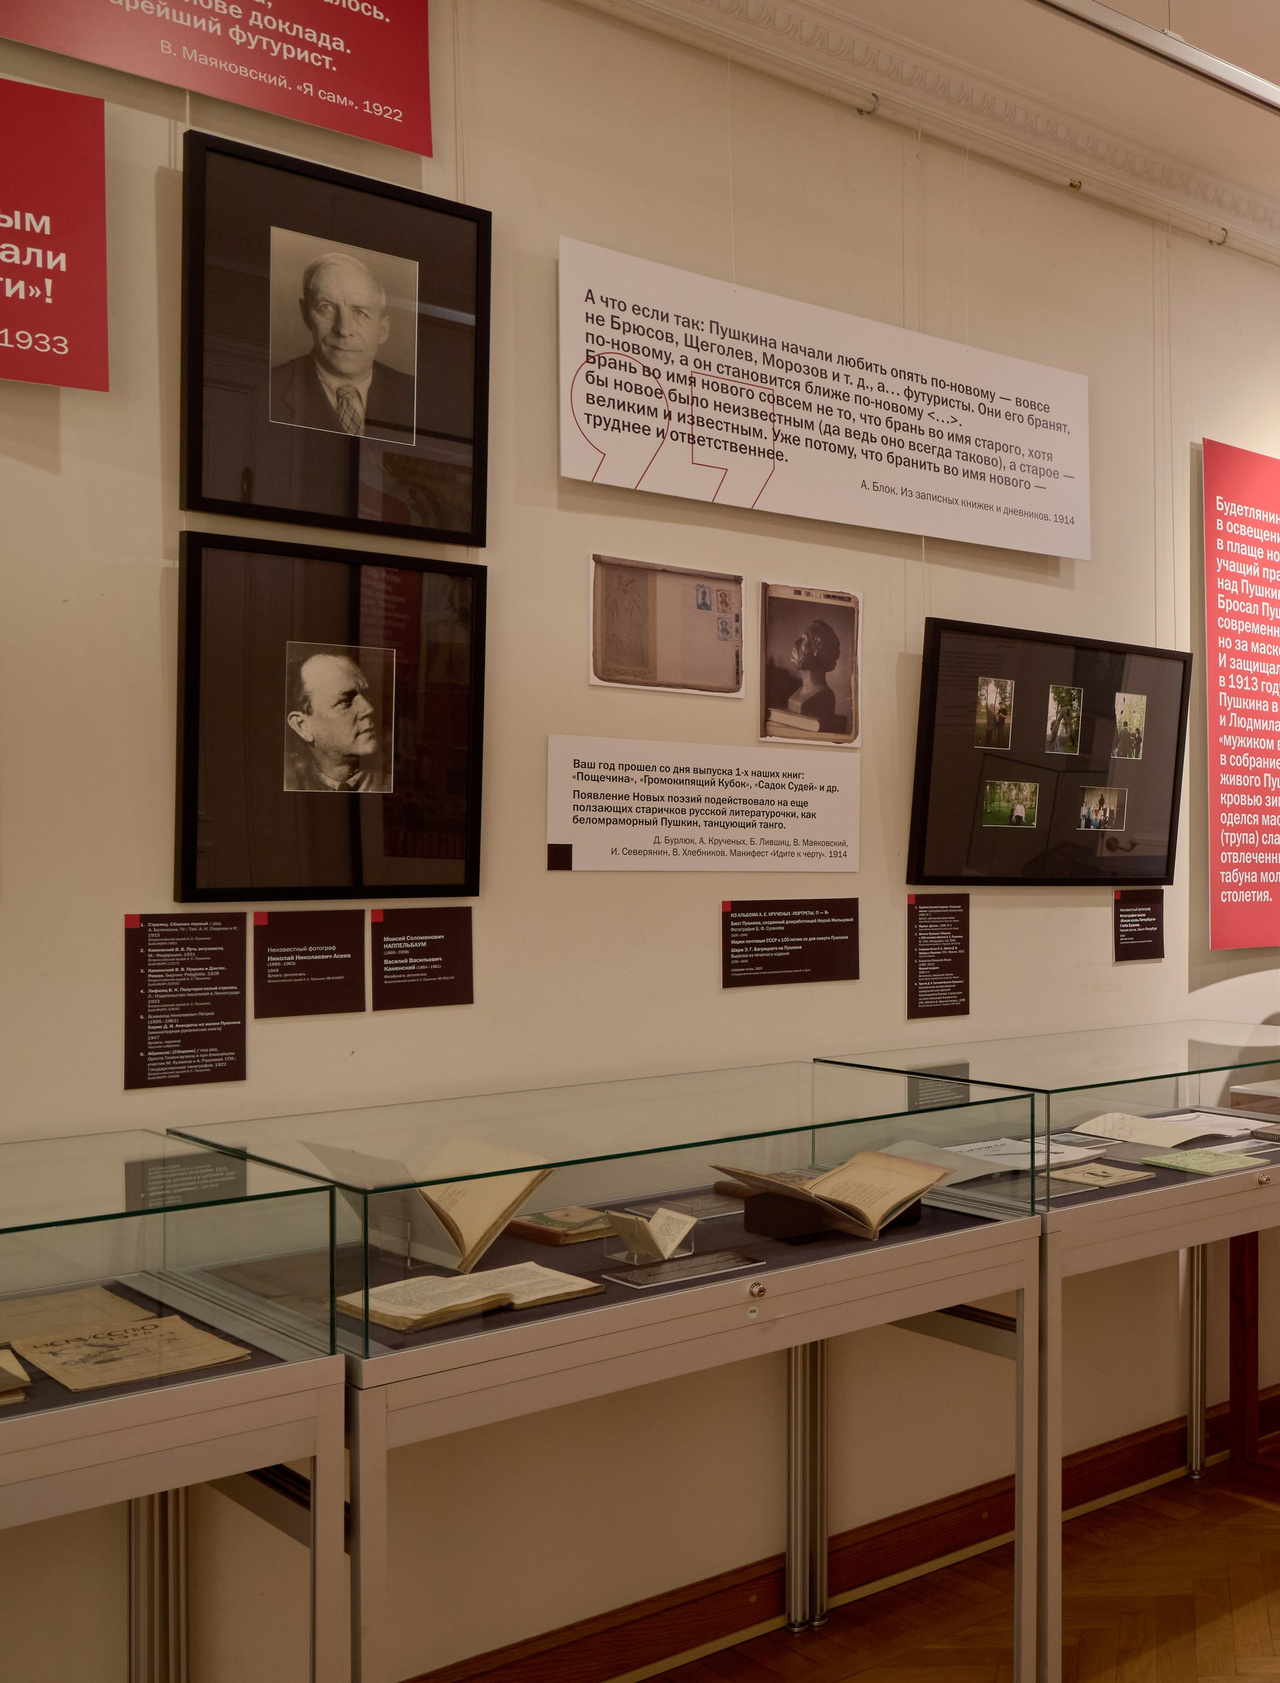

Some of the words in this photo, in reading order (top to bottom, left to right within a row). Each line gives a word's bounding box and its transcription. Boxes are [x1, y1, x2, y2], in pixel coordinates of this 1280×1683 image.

[249, 10, 352, 54] доклада.
[228, 24, 338, 72] футурист.
[160, 39, 177, 56] В.
[182, 45, 293, 90] Маяковский.
[296, 81, 314, 96] «Я
[318, 88, 359, 110] сам».
[363, 100, 403, 123] 1922
[0, 276, 53, 304] и»!
[0, 328, 69, 355] 1933
[585, 331, 674, 365] по-новому,
[679, 354, 688, 366] а
[693, 357, 711, 371] он
[716, 363, 800, 391] становится
[804, 380, 850, 402] ближе
[854, 393, 923, 421] по-новому
[585, 349, 637, 373] Брань
[641, 363, 661, 379] во
[666, 370, 696, 387] имя
[701, 378, 754, 399] нового
[759, 391, 812, 412] совсем
[816, 403, 833, 416] не
[836, 407, 855, 423] то,
[859, 412, 881, 426] что
[885, 416, 925, 435] брань
[928, 427, 944, 439] во
[947, 431, 971, 445] имя
[974, 437, 1024, 458] старого,
[1027, 448, 1052, 462] хотя
[584, 412, 651, 435] труднее
[656, 427, 665, 439] и
[670, 430, 788, 462] ответственнее.
[860, 479, 869, 490] А.
[872, 481, 898, 495] Блок.
[900, 486, 913, 498] Из
[915, 490, 959, 505] записных
[960, 499, 994, 512] книжек
[995, 505, 1001, 513] и
[1002, 506, 1051, 521] дневников.
[1053, 513, 1074, 525] 1914
[1216, 518, 1223, 530] в
[1216, 538, 1223, 550] в
[1226, 540, 1263, 560] плаще
[1216, 557, 1259, 577] учащий
[1218, 593, 1258, 614] Бросал
[1218, 636, 1232, 649] но
[1234, 639, 1248, 651] за
[1219, 675, 1225, 687] в
[1228, 673, 1258, 691] 1913
[1218, 734, 1274, 750] «мужиком
[573, 758, 595, 769] Ваш
[598, 762, 615, 772] год
[618, 763, 656, 772] прошел
[658, 765, 670, 773] со
[672, 765, 690, 774] дня
[692, 766, 733, 777] выпуска
[735, 767, 749, 776] 1-х
[750, 770, 780, 778] наших
[781, 771, 804, 779] книг:
[572, 771, 637, 784] «Пощечина»,
[639, 774, 715, 787] «Громокипящий
[718, 778, 752, 789] Кубок»,
[754, 779, 786, 790] «Садок
[787, 781, 817, 792] Судей»
[825, 785, 839, 793] др.
[572, 789, 630, 801] Появление
[632, 791, 665, 802] Новых
[667, 794, 702, 803] поэзий
[704, 795, 775, 806] подействовало
[790, 799, 808, 808] еще
[1220, 812, 1258, 826] оделся
[610, 847, 619, 855] И.
[621, 846, 670, 857] Северянин,
[672, 847, 680, 856] В.
[681, 848, 727, 856] Хлебников.
[729, 848, 768, 858] Манифест
[828, 850, 847, 858] 1914
[1219, 868, 1257, 886] табуна
[308, 945, 337, 953] фотограф
